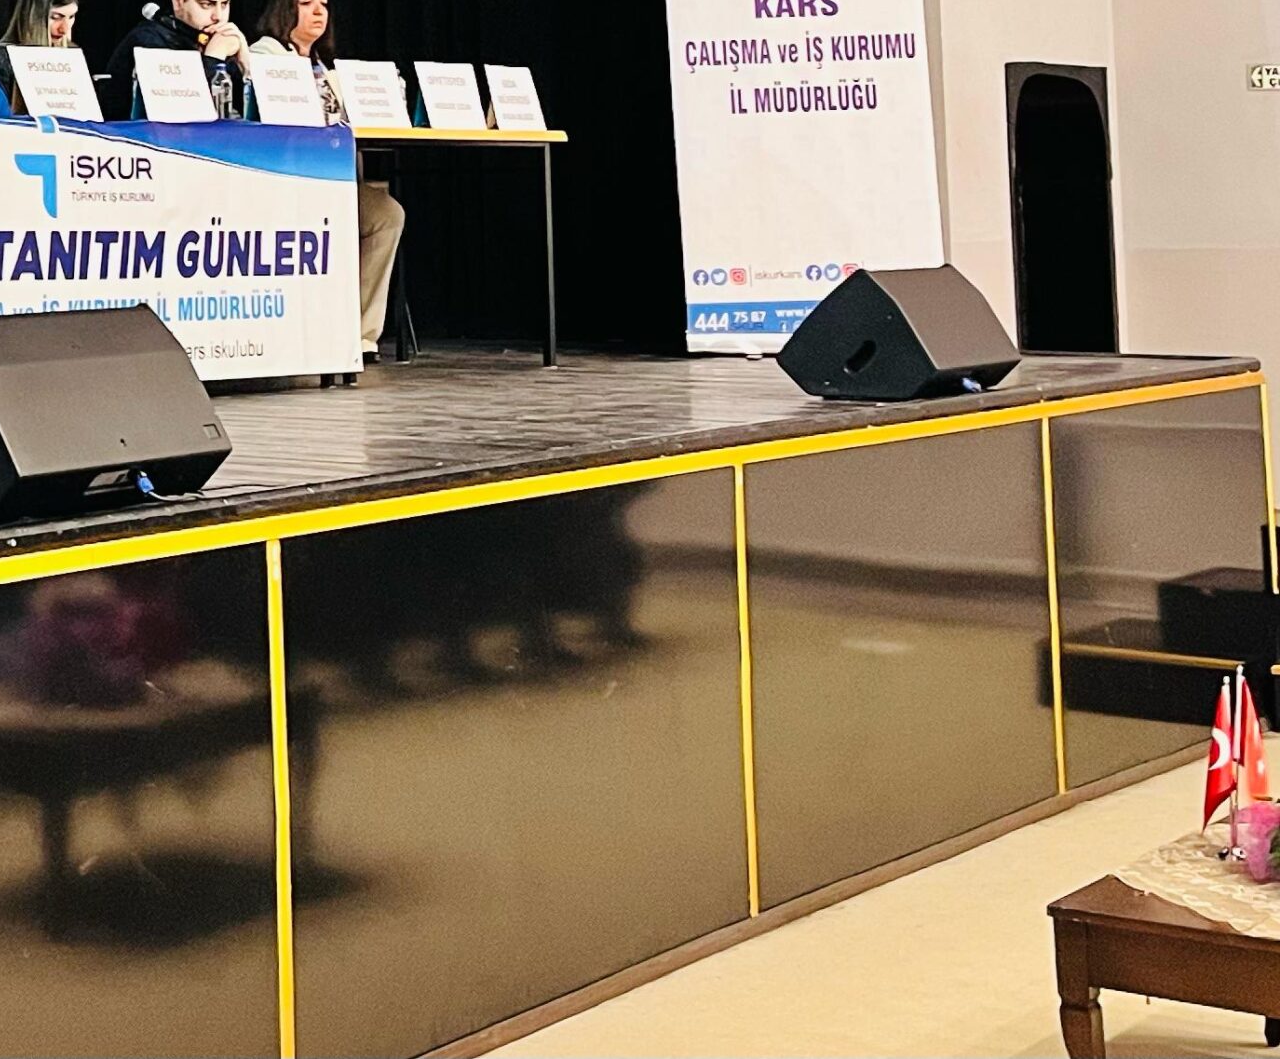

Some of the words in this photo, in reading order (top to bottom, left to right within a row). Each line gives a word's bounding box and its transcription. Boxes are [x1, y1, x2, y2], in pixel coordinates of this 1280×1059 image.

[685, 38, 772, 73] ÇALIŞMA
[778, 43, 799, 63] ve
[805, 30, 824, 69] İŞ
[831, 33, 916, 61] KURUMU
[730, 83, 748, 114] İL
[754, 77, 877, 113] MÜDÜRLÜĞÜ
[176, 217, 330, 278] GÜNLERİ
[178, 288, 285, 322] MÜDÜRLÜĞÜ
[694, 312, 730, 331] 444
[733, 311, 749, 323] 75
